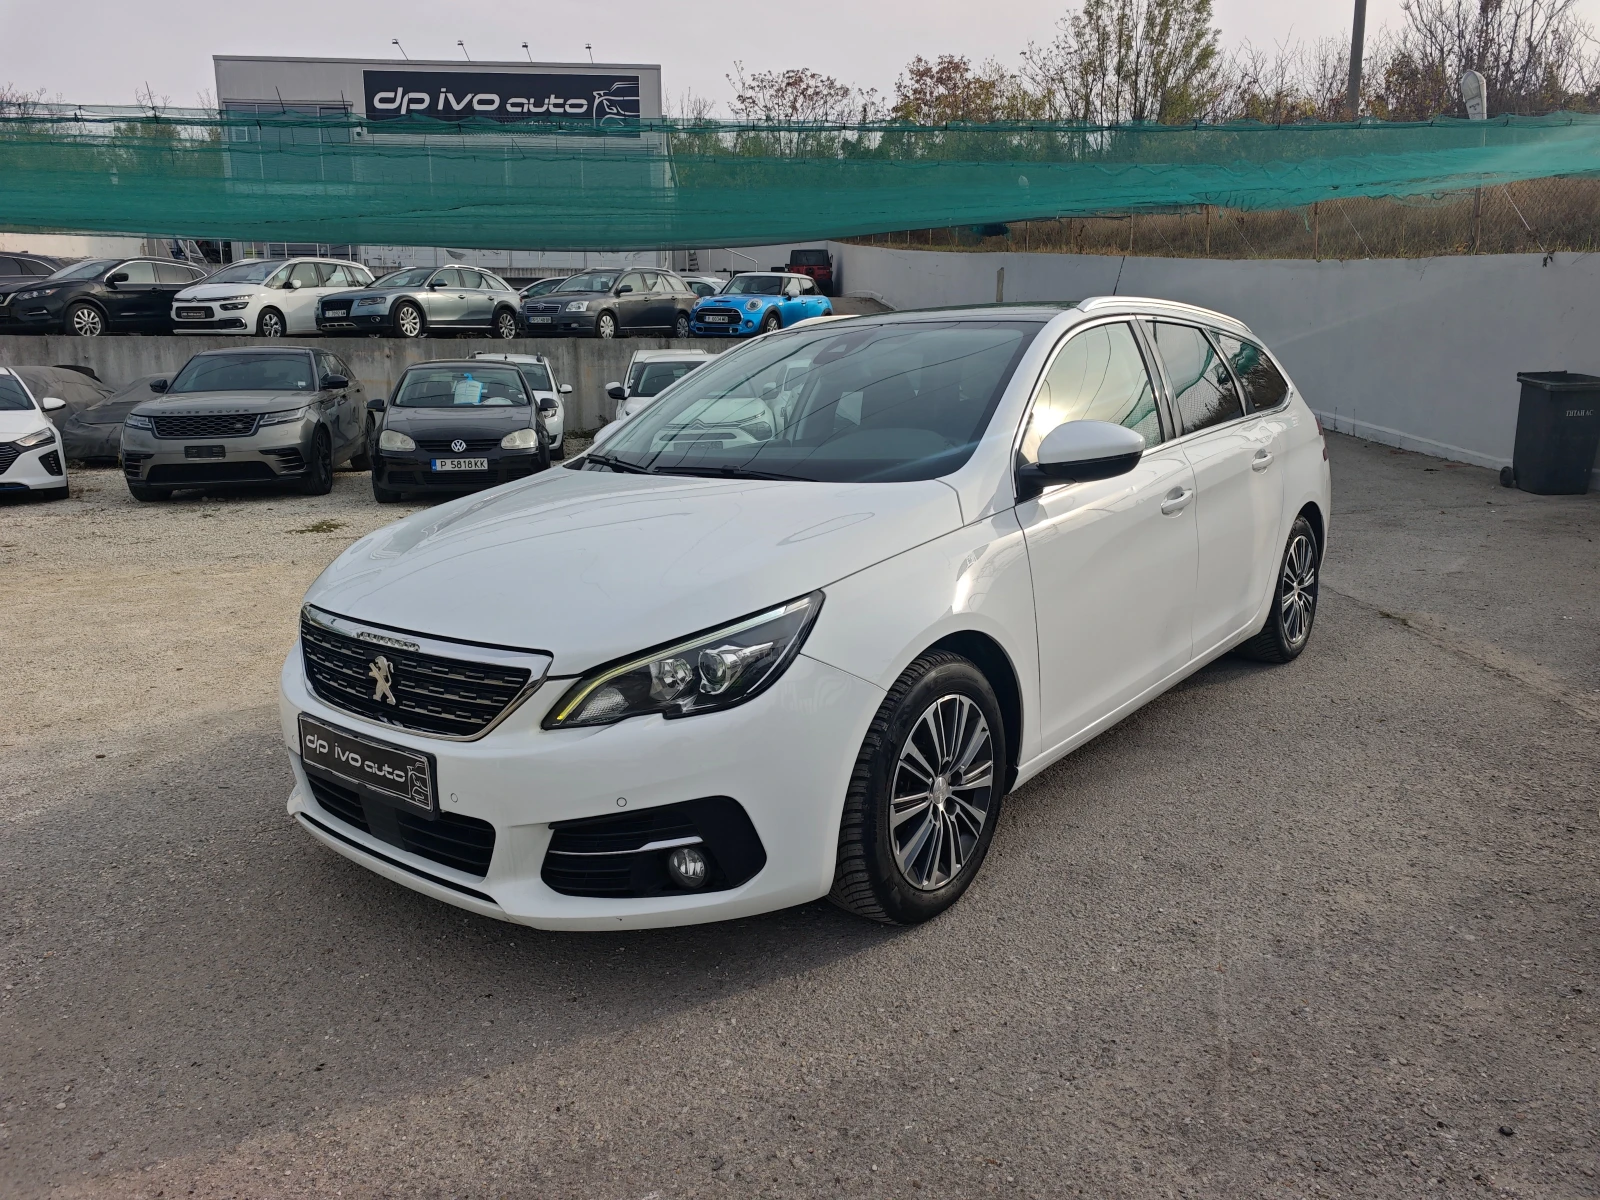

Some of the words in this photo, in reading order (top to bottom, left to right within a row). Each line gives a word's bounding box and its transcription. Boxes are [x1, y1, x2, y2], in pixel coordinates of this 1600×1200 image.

[373, 87, 430, 114] dp
[437, 88, 500, 110] ivo
[506, 94, 588, 113] auto
[440, 460, 447, 469] P
[305, 734, 328, 754] dp
[334, 743, 362, 767] ivo
[363, 761, 406, 782] auto
